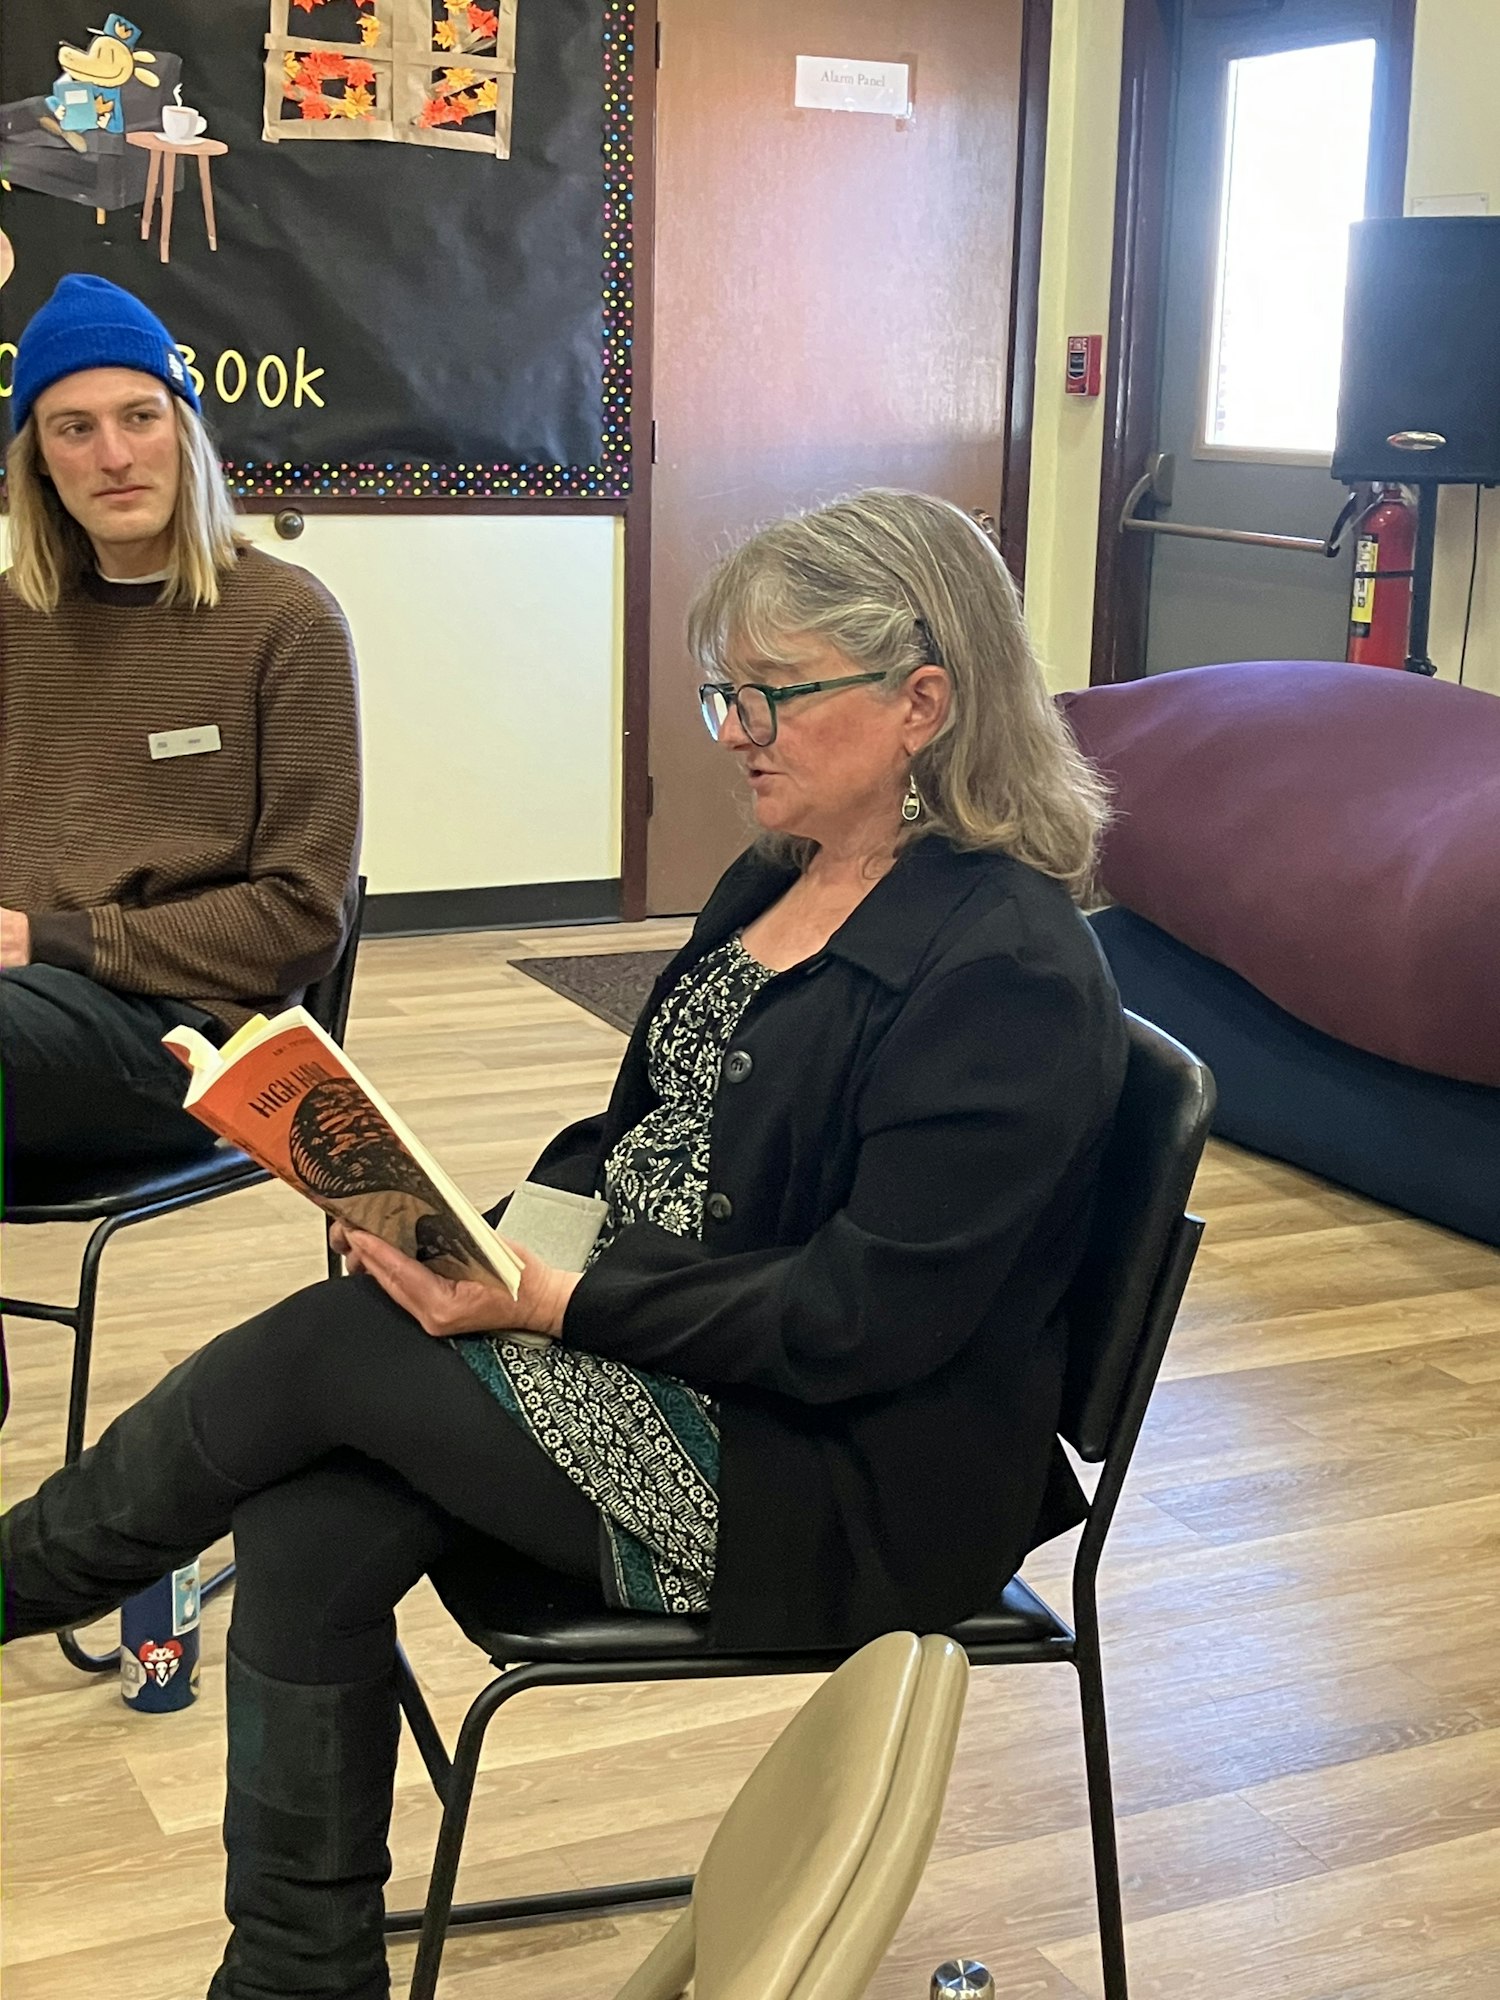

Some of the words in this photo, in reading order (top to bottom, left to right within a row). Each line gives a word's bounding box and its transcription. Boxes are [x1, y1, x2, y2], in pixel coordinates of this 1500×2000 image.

[820, 70, 855, 86] Alarm
[857, 73, 885, 87] Panel
[248, 1077, 302, 1118] HIGH
